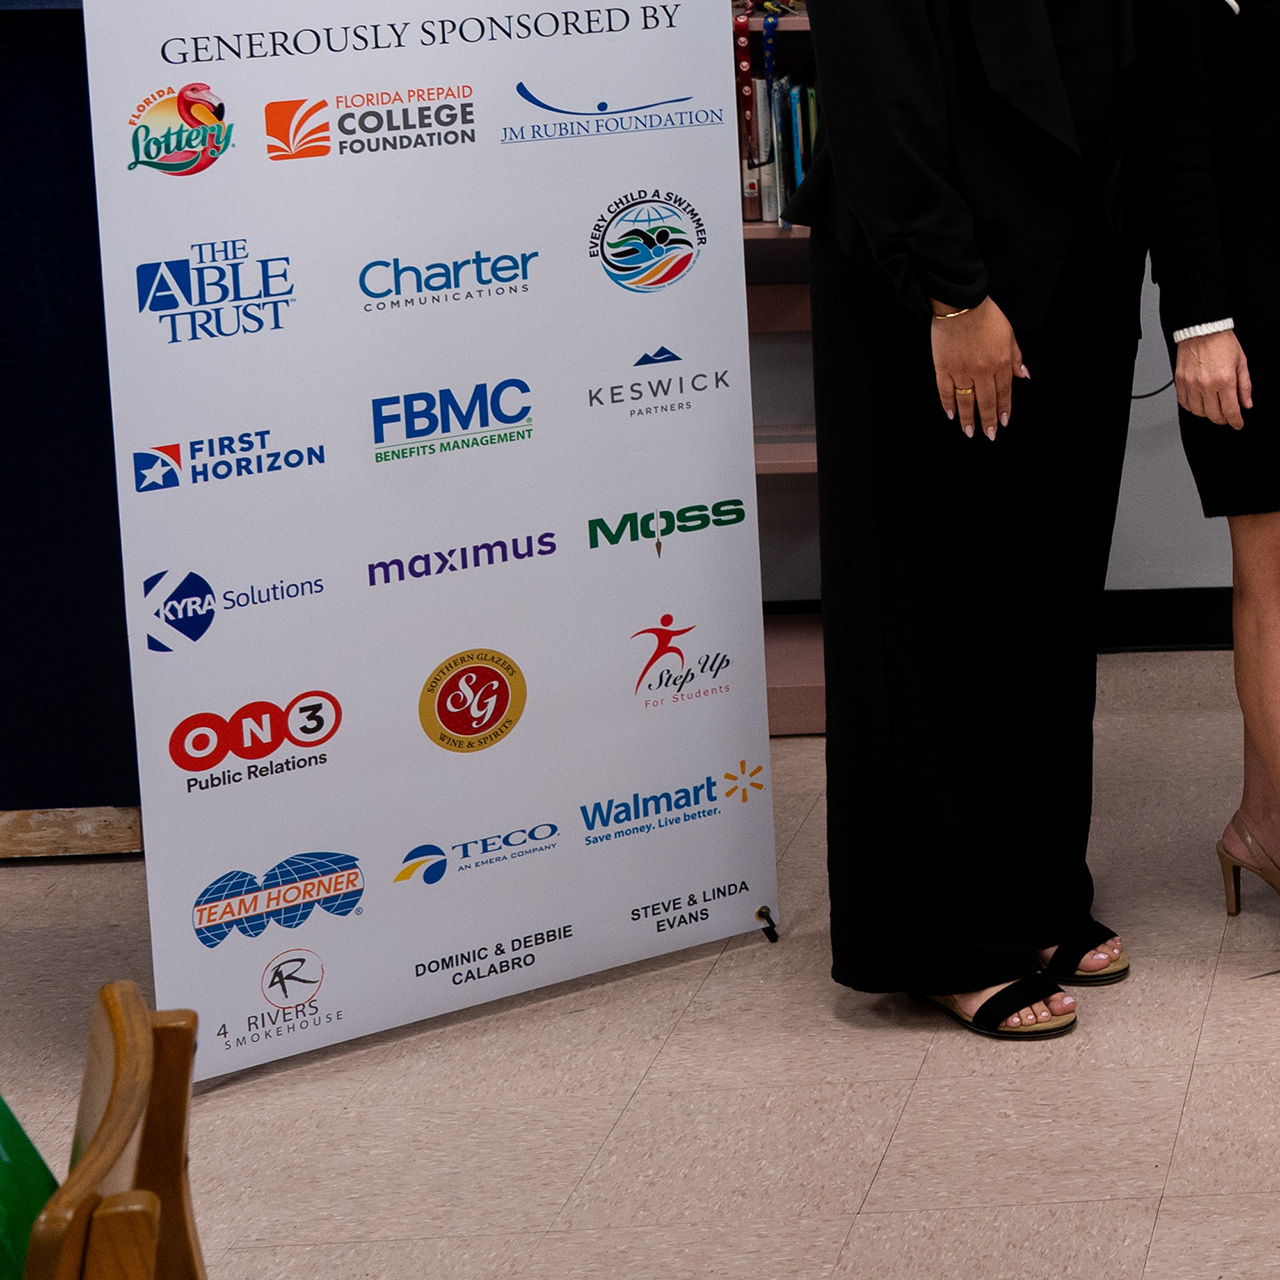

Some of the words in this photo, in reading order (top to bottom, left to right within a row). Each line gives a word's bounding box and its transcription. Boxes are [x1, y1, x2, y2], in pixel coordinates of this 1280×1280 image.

[161, 23, 410, 64] GENEROUSLY
[421, 8, 629, 46] SPONSORED
[641, 4, 681, 29] BY
[128, 86, 176, 126] FLORIDA
[336, 91, 404, 109] FLORIDA
[408, 85, 472, 102] PREPAID
[338, 103, 474, 135] COLLEGE
[501, 124, 524, 144] JM
[529, 118, 591, 139] RUBIN
[595, 107, 724, 132] FOUNDATION
[127, 123, 234, 172] Lottery
[339, 129, 475, 155] FOUNDATION
[589, 214, 608, 258] EVERY
[607, 189, 647, 215] CHILD
[651, 189, 660, 199] A
[664, 191, 707, 246] SWIMMER
[191, 239, 249, 264] THE
[137, 257, 295, 313] ABLE
[359, 251, 539, 301] Charter
[364, 285, 528, 311] COMMUNICATIONS
[159, 299, 289, 343] TRUST
[589, 370, 729, 411] KESWICK
[630, 402, 691, 417] PARTNERS
[371, 378, 532, 444] FBMC
[190, 430, 270, 460] FIRST
[190, 439, 325, 483] HORIZON
[374, 440, 437, 464] BENEFITS
[439, 428, 533, 454] MANAGEMENT
[587, 498, 745, 549] MOSS
[368, 533, 556, 586] maximus
[157, 592, 216, 622] KYRA
[223, 579, 323, 609] Solutions
[427, 654, 474, 693] SOUTHERN
[648, 668, 695, 693] Step
[698, 652, 730, 679] Up
[446, 673, 499, 728] SG
[645, 699, 665, 709] For
[672, 685, 730, 703] Students
[185, 701, 325, 758] ON3
[439, 732, 464, 748] WINE
[478, 718, 513, 746] SPIRITS
[187, 770, 242, 793] Public
[247, 754, 327, 779] Relations
[580, 776, 717, 835] Walmart
[451, 823, 559, 859] TECO
[584, 828, 612, 845] Save
[614, 824, 655, 838] money.
[658, 817, 681, 828] Live
[684, 808, 721, 821] better.
[458, 864, 471, 872] AN
[474, 855, 508, 868] EMERA
[511, 842, 557, 859] COMPANY
[195, 893, 259, 926] TEAM
[265, 870, 359, 909] HORNER
[630, 900, 682, 922] STEVE
[688, 894, 698, 906] &
[703, 881, 749, 902] LINDA
[652, 903, 709, 932] EVANS
[415, 947, 488, 983] DOMINIC
[495, 943, 505, 956] &
[511, 925, 573, 952] DEBBIE
[451, 953, 536, 985] CALABRO
[216, 1024, 229, 1038] 4
[248, 999, 319, 1032] RIVERS
[225, 1010, 343, 1050] SMOKEHOUSE
